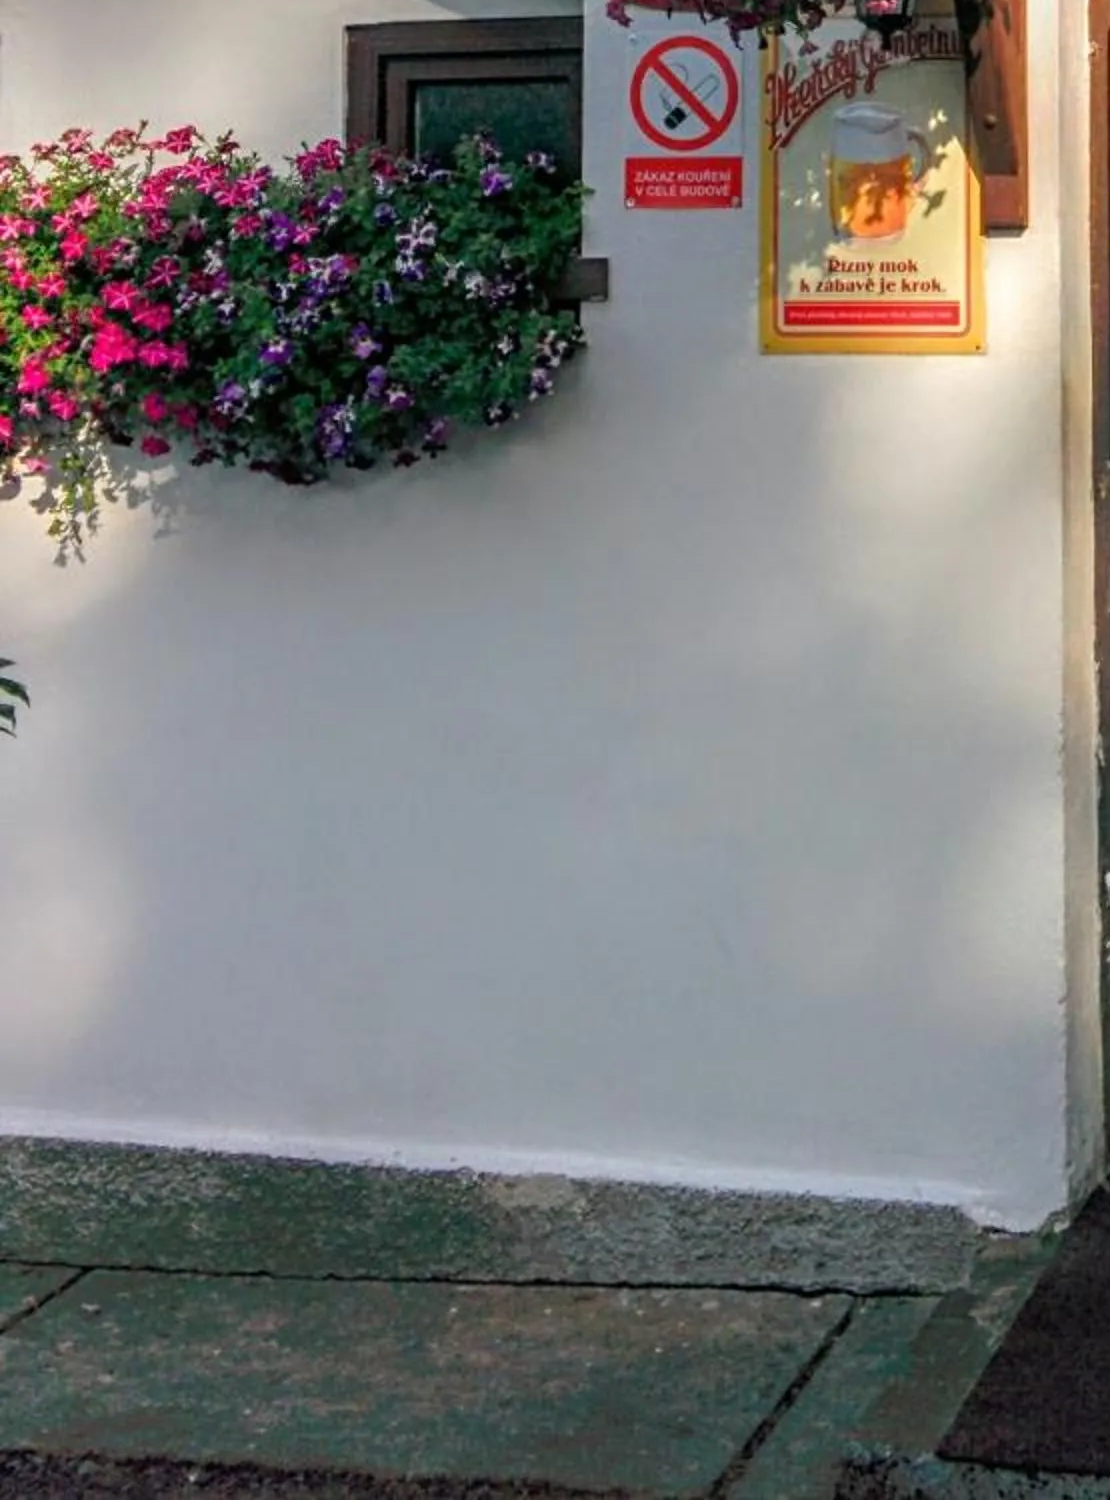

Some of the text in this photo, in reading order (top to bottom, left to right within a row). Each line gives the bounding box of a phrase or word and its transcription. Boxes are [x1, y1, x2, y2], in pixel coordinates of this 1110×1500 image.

[635, 185, 645, 197] V
[880, 258, 919, 273] mok
[800, 278, 810, 293] k
[879, 277, 897, 295] je
